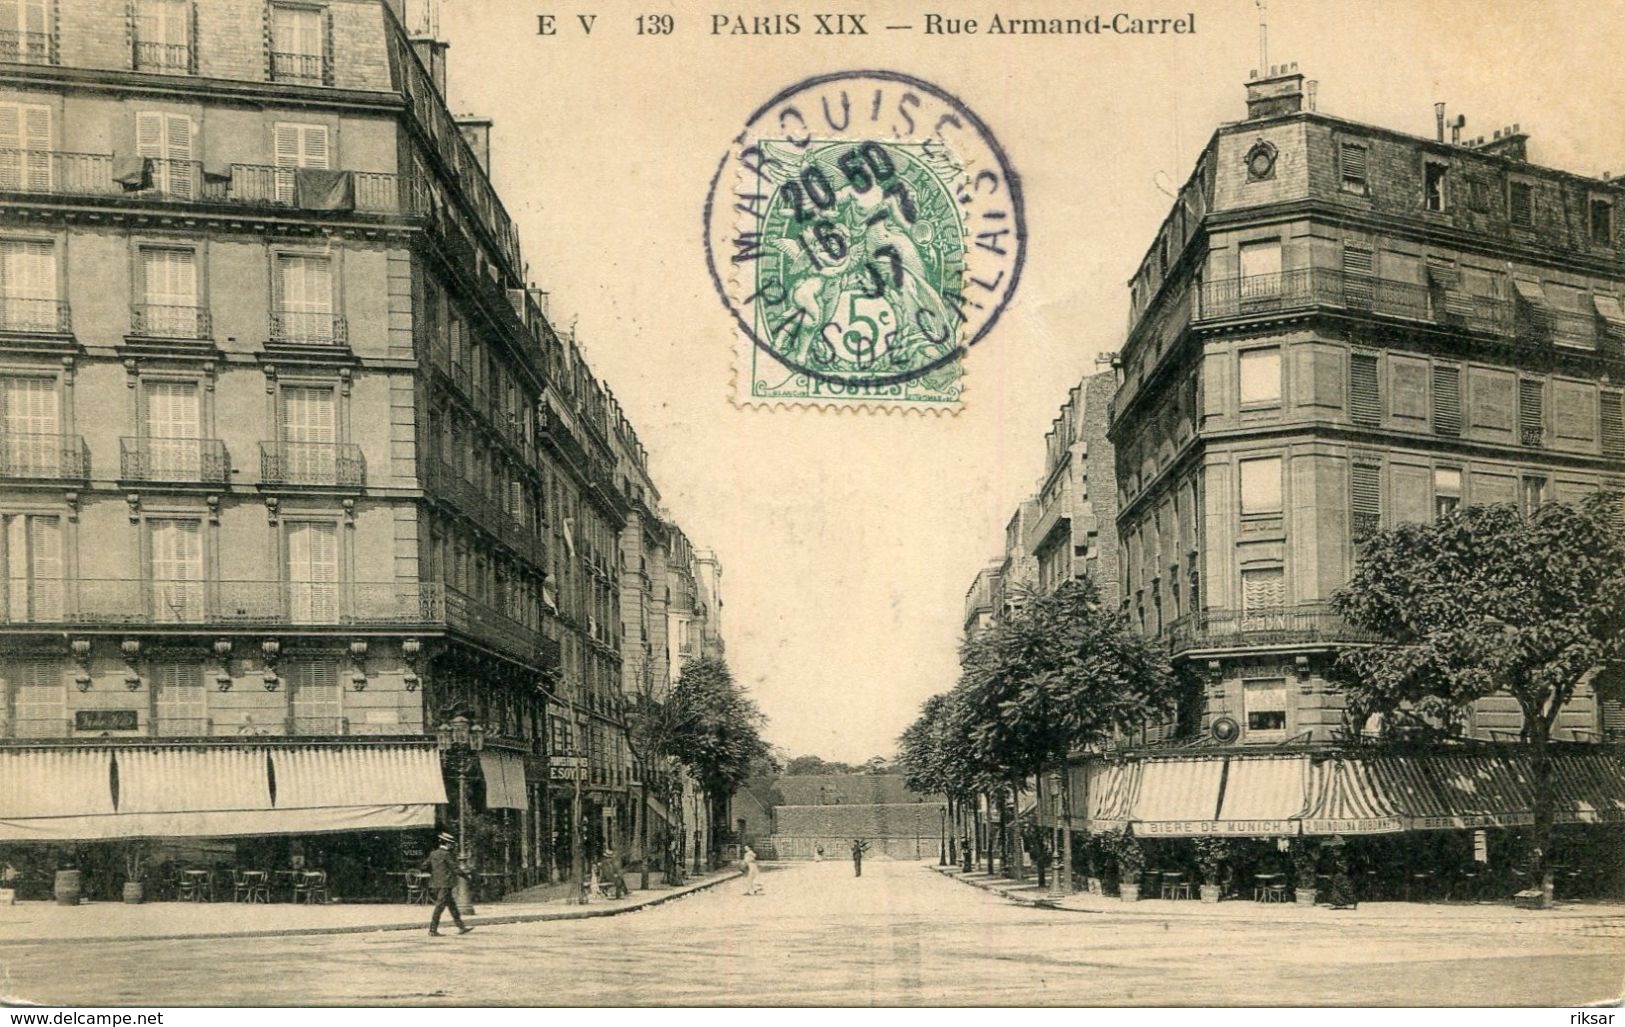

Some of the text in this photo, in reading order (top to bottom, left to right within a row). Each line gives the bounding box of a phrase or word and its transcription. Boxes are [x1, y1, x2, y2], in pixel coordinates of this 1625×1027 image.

[536, 13, 1197, 35] E V 139 PARIS XIX Rue Armand-Carrel
[812, 372, 902, 396] POSTES
[1201, 822, 1218, 832] DE
[1227, 821, 1281, 832] MUNICH
